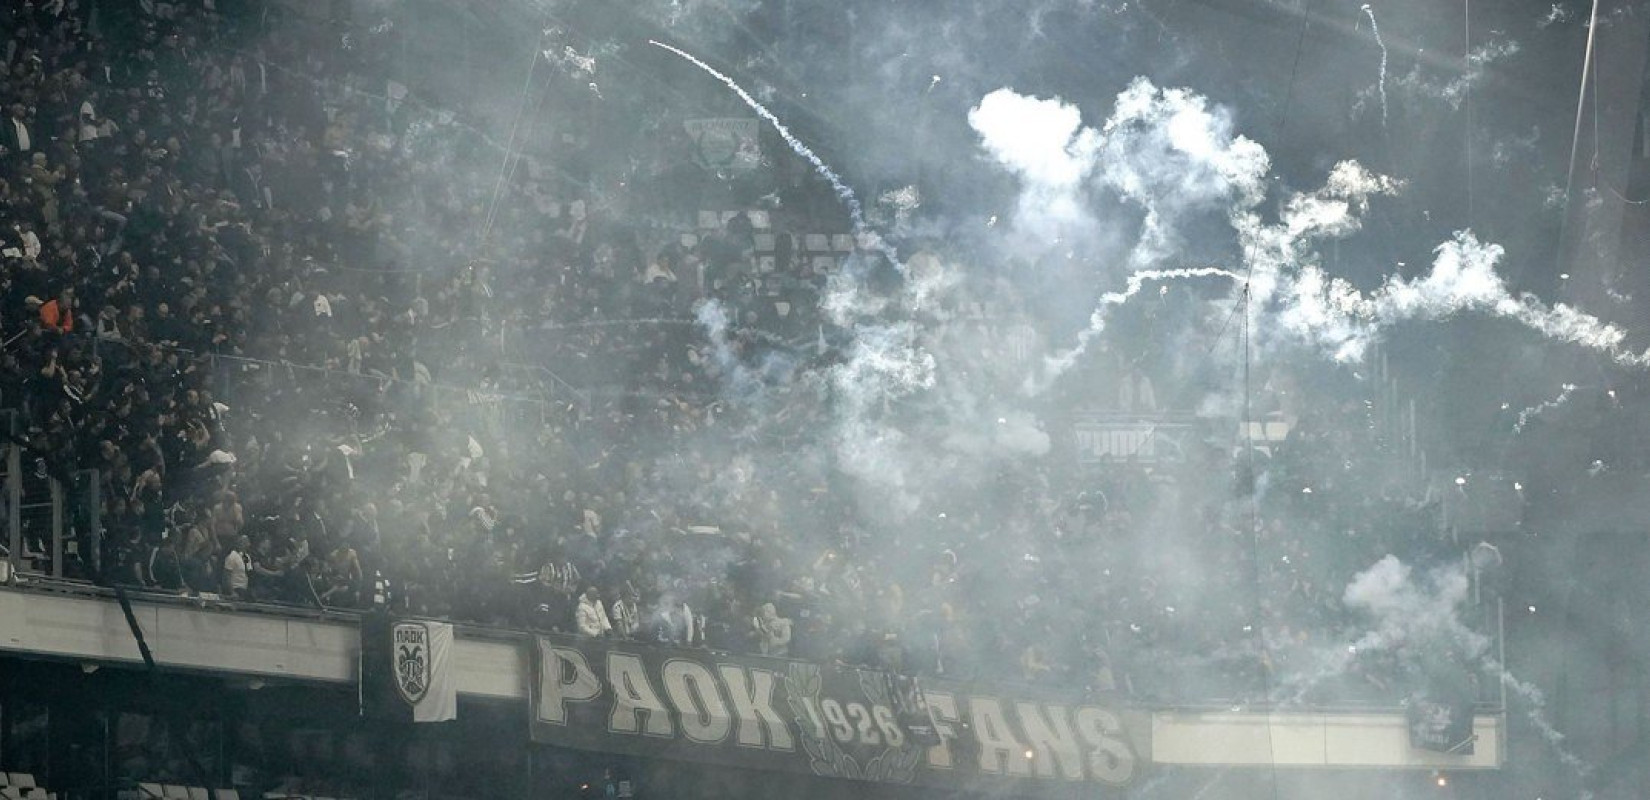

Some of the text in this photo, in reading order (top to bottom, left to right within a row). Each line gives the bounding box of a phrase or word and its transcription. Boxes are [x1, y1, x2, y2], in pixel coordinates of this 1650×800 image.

[537, 639, 1138, 787] PAOK 1926 FANS
